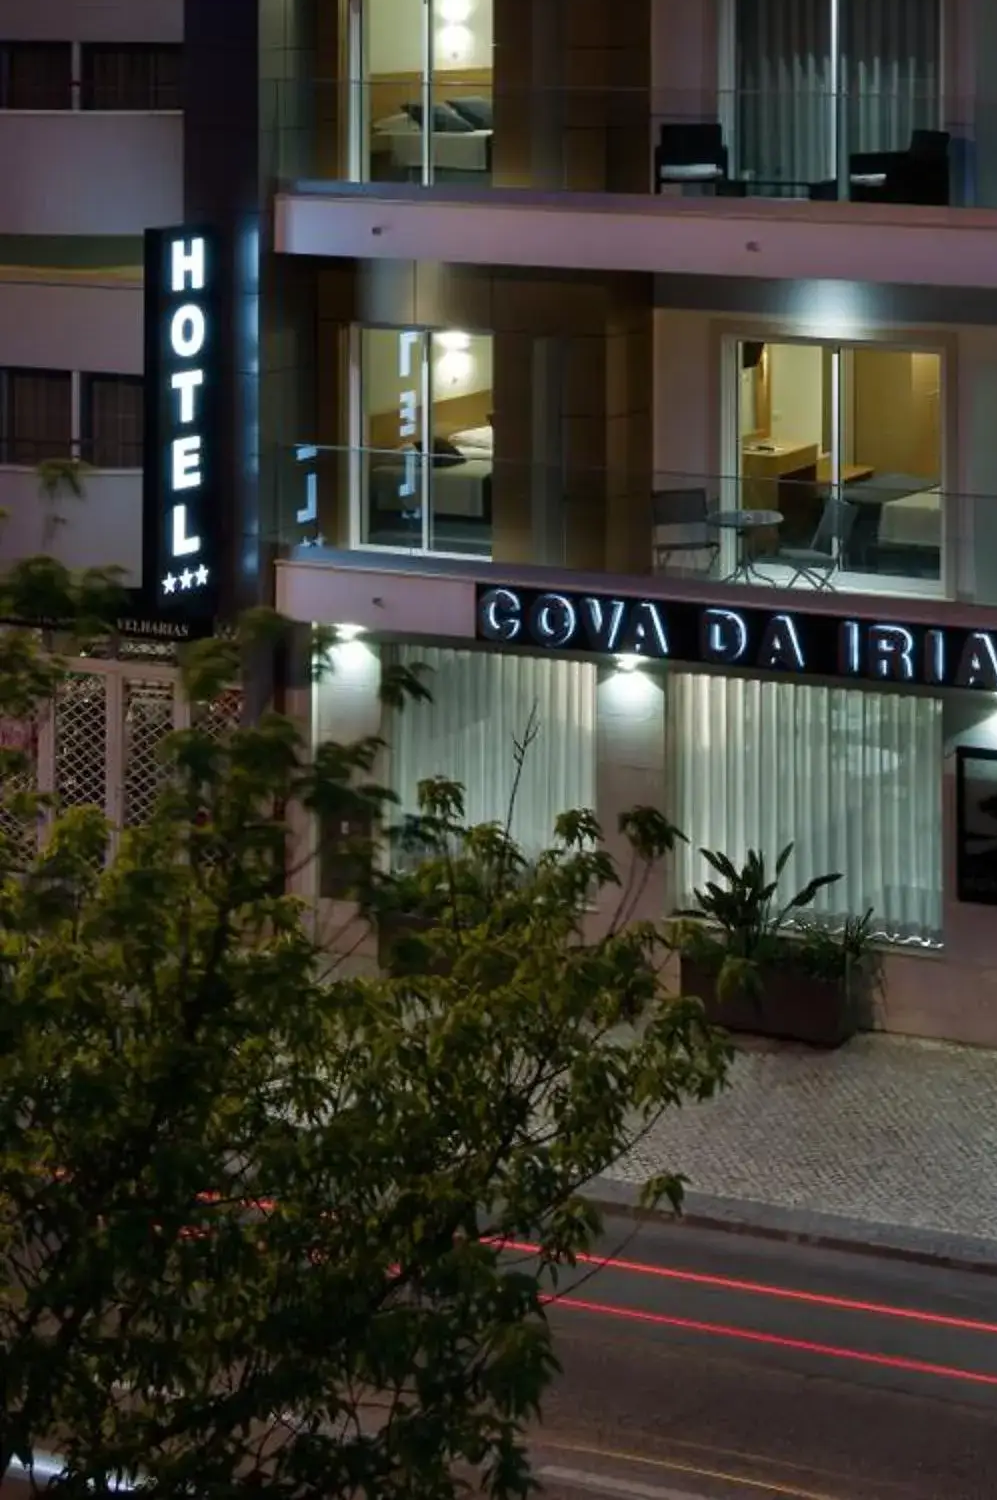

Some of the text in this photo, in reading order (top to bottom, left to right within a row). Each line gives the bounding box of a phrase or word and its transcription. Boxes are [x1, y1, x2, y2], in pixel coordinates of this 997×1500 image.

[171, 237, 206, 557] HOTEL
[481, 588, 669, 654] COVA
[702, 608, 805, 670] DA
